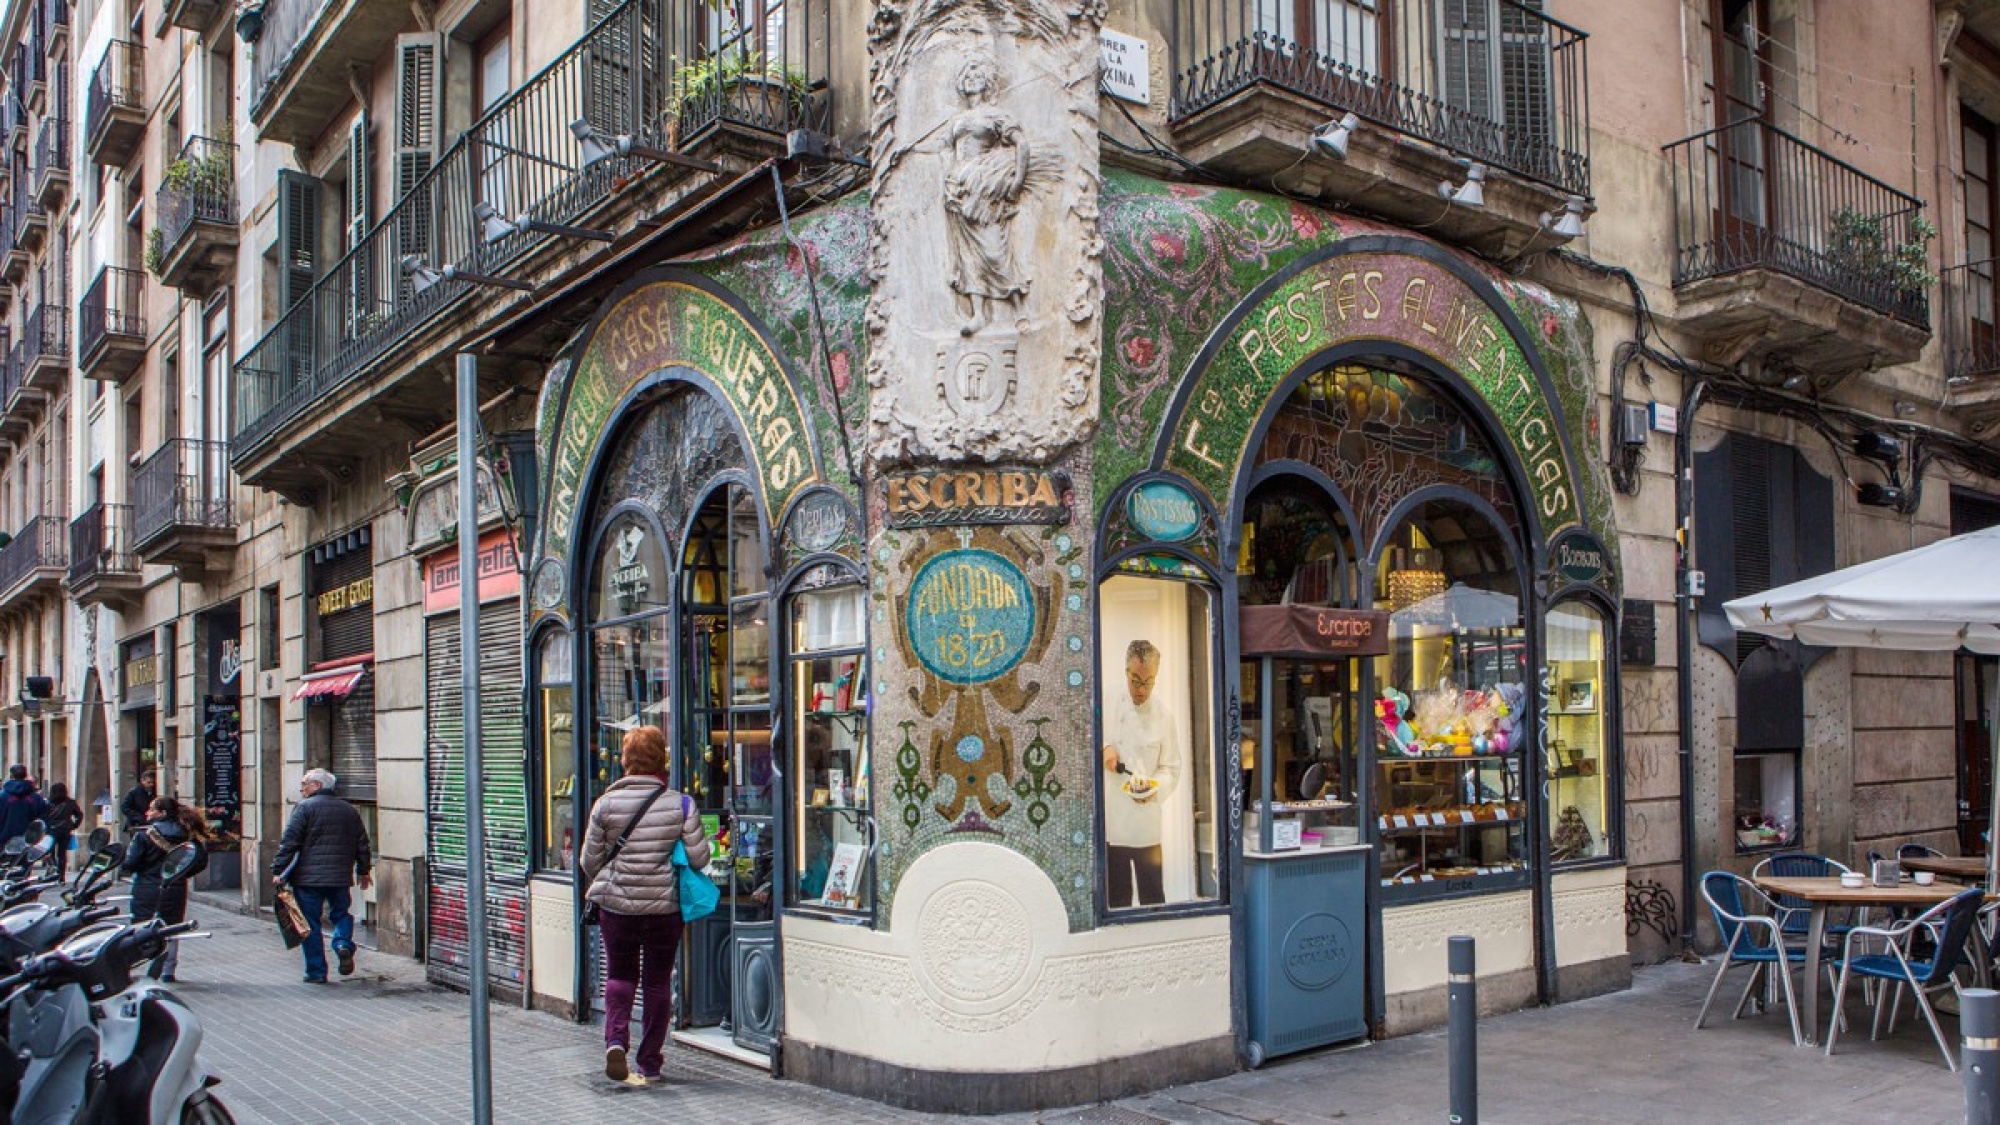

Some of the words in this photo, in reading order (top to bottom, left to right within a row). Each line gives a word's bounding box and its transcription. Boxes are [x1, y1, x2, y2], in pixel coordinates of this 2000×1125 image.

[1099, 38, 1127, 53] RRER
[1108, 52, 1122, 65] LA
[1105, 67, 1135, 87] XINA
[1238, 271, 1383, 382] PASTAS
[1402, 277, 1568, 517] ALIMENTICIAS
[554, 361, 610, 537] ANTIGUA
[610, 302, 674, 371] CASA
[684, 302, 802, 490] FIGUERAS
[429, 541, 517, 593] lametta
[917, 563, 1018, 617] FUNDADA
[936, 630, 1005, 667] 1820
